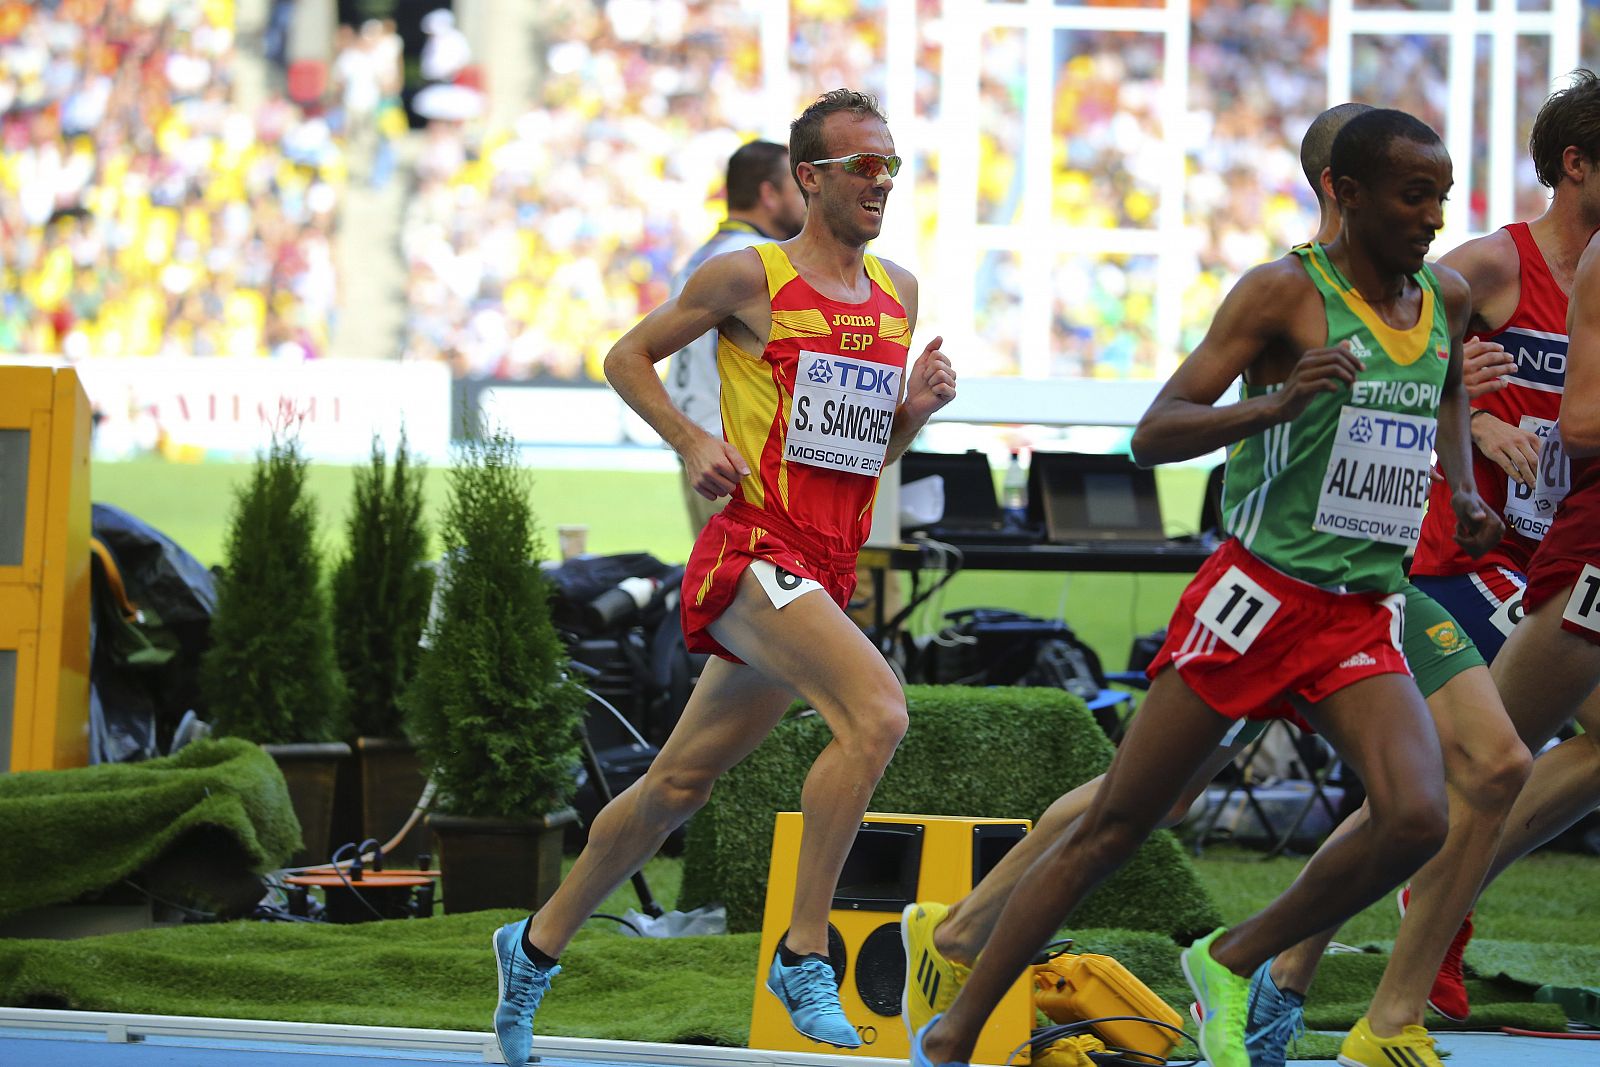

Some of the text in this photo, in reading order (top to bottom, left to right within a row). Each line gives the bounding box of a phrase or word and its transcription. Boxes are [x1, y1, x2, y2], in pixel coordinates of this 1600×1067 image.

[839, 332, 874, 351] ESP
[1517, 346, 1567, 373] NO
[833, 361, 895, 396] TDK
[1350, 380, 1442, 410] ETHIOPI
[794, 394, 893, 446] S. SÁNCHEZ
[1375, 418, 1437, 452] TDK
[787, 444, 882, 472] MOSCOW 2013
[1327, 457, 1429, 509] ALAMIRE
[1534, 498, 1551, 511] 13
[1318, 512, 1420, 541] MOSCOW 20
[1505, 513, 1550, 535] MOSC
[1215, 583, 1264, 638] 11
[1578, 574, 1600, 618] 1
